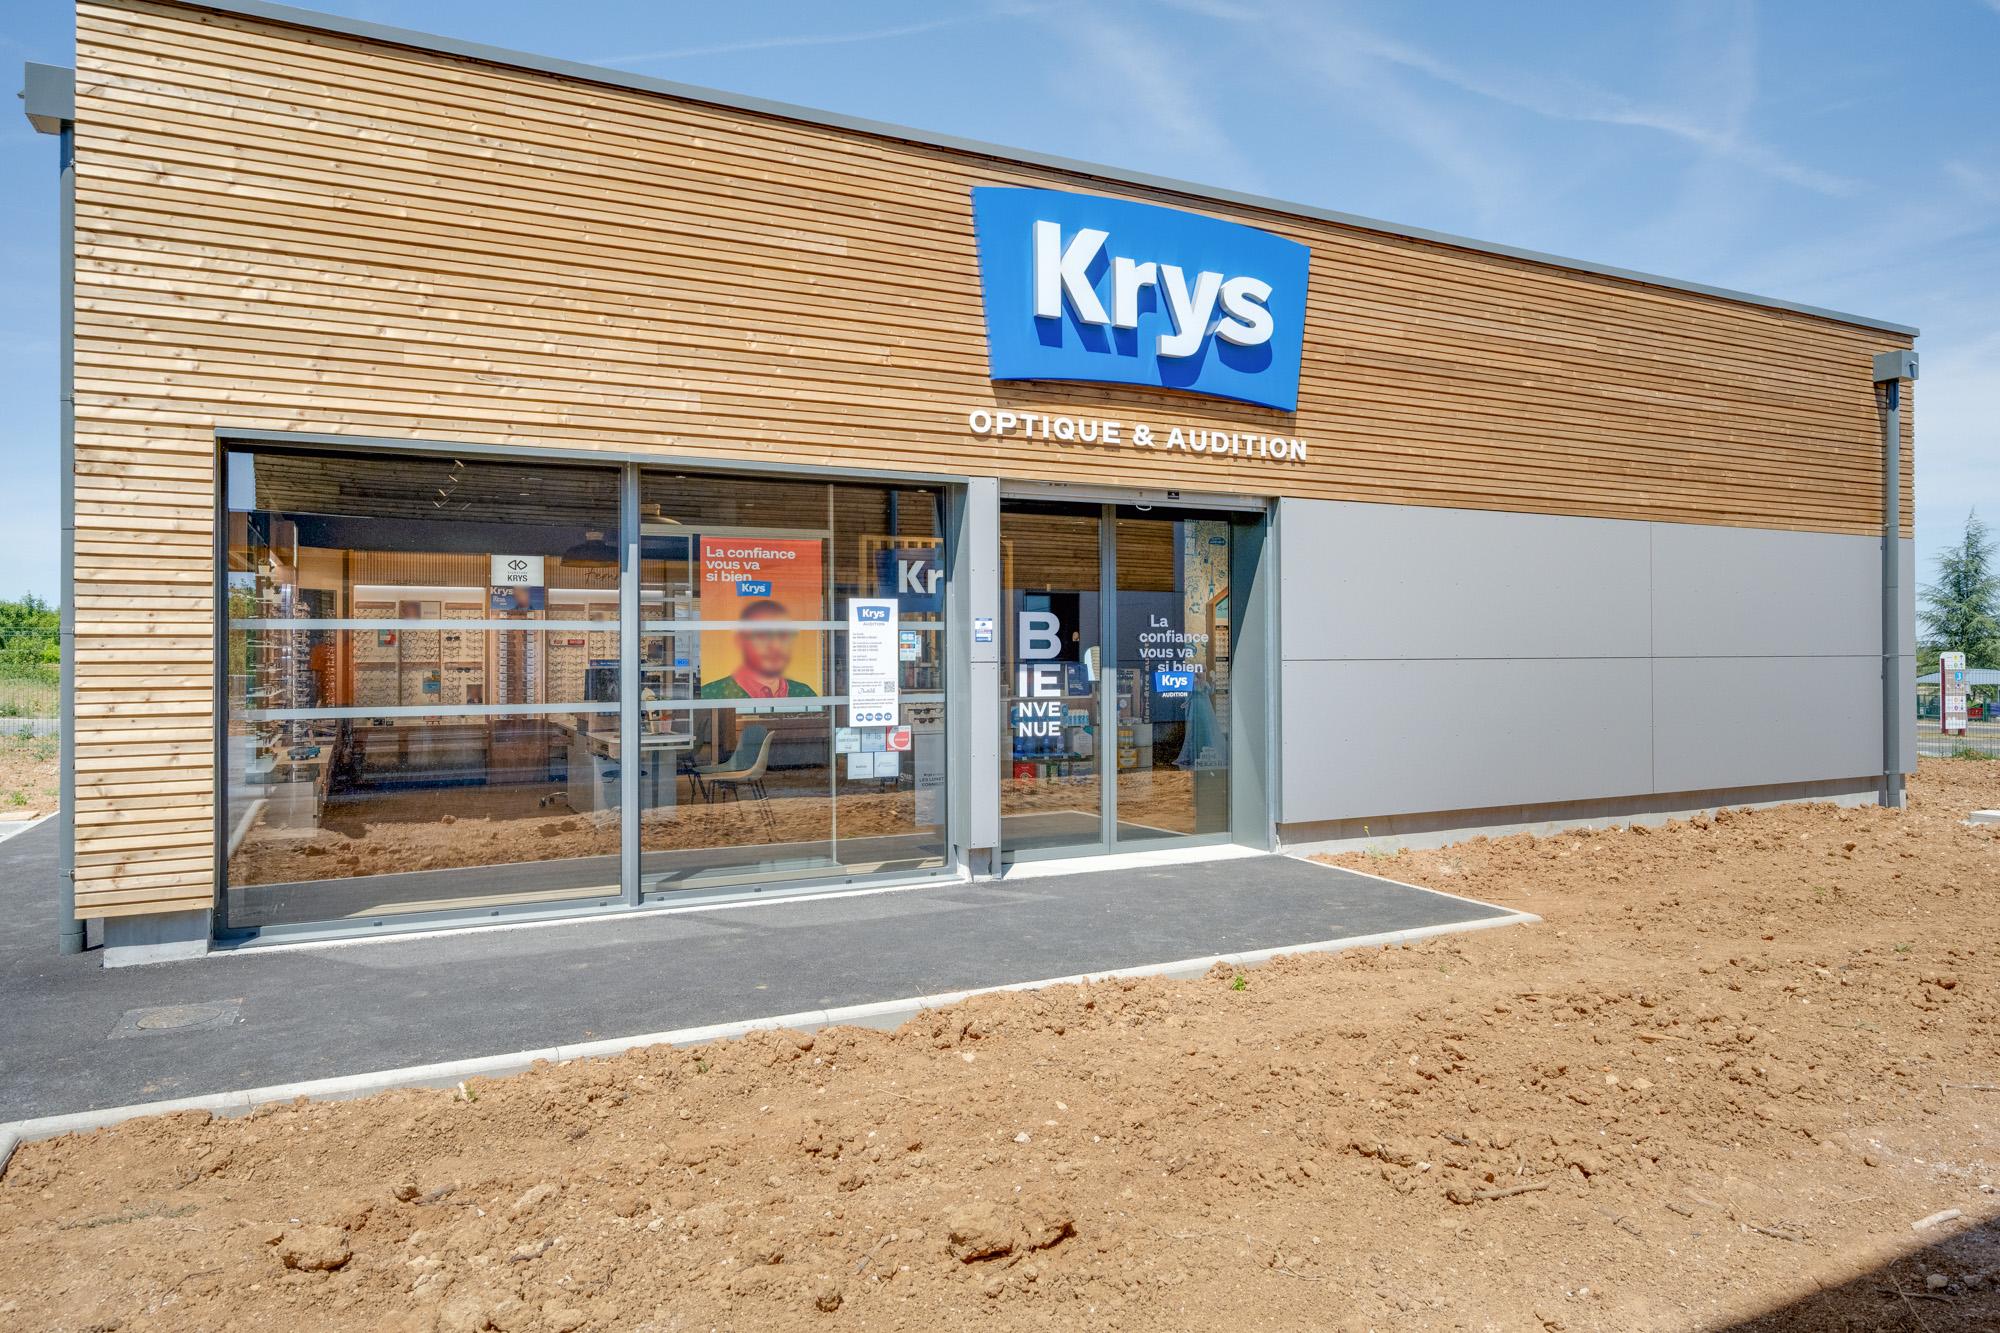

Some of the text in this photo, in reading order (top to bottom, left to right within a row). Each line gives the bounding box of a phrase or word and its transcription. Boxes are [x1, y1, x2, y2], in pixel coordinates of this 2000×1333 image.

[1033, 220, 1274, 358] Krys
[969, 410, 1307, 460] OPTIQUE & AUDITION
[706, 546, 796, 559] La confiance
[706, 560, 760, 570] vous va
[507, 574, 528, 582] KRYS
[706, 571, 752, 582] si bien
[490, 587, 513, 596] Krys
[741, 583, 766, 594] Krys
[862, 608, 885, 619] Krys
[1150, 614, 1168, 627] La
[1139, 630, 1209, 643] confiance
[1139, 648, 1194, 658] vous va
[1158, 661, 1203, 673] si bien
[1162, 675, 1188, 688] Krys
[1020, 702, 1061, 717] NVE
[1020, 721, 1061, 736] NUE
